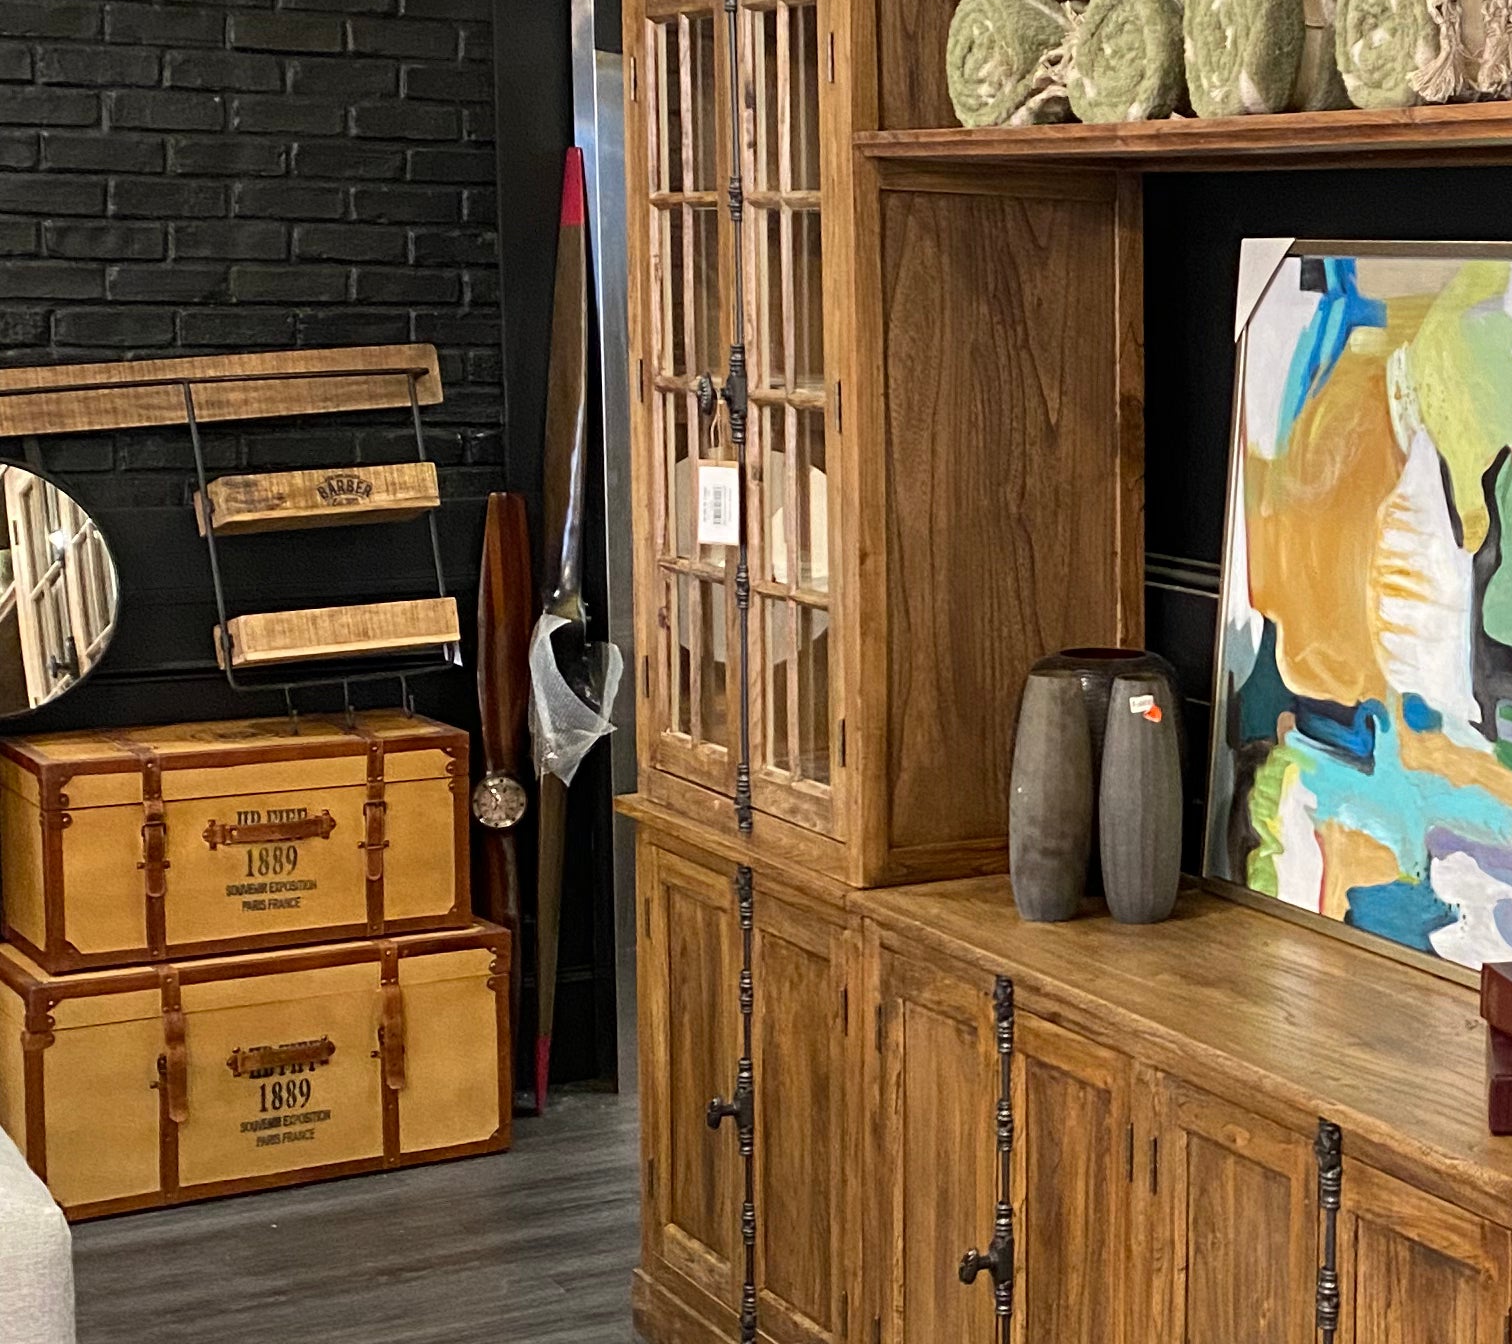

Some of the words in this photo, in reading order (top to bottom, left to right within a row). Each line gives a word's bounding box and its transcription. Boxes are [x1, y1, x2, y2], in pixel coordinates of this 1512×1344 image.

[317, 479, 372, 500] BARBER
[246, 845, 298, 877] 1889
[269, 879, 317, 893] EXPOSITION
[242, 899, 266, 912] PARIS
[267, 897, 301, 910] FRANCE
[260, 1078, 311, 1112] 1889
[283, 1109, 331, 1126] EXPOSITION
[256, 1134, 281, 1147] PARIS
[282, 1129, 315, 1143] FRANCE
